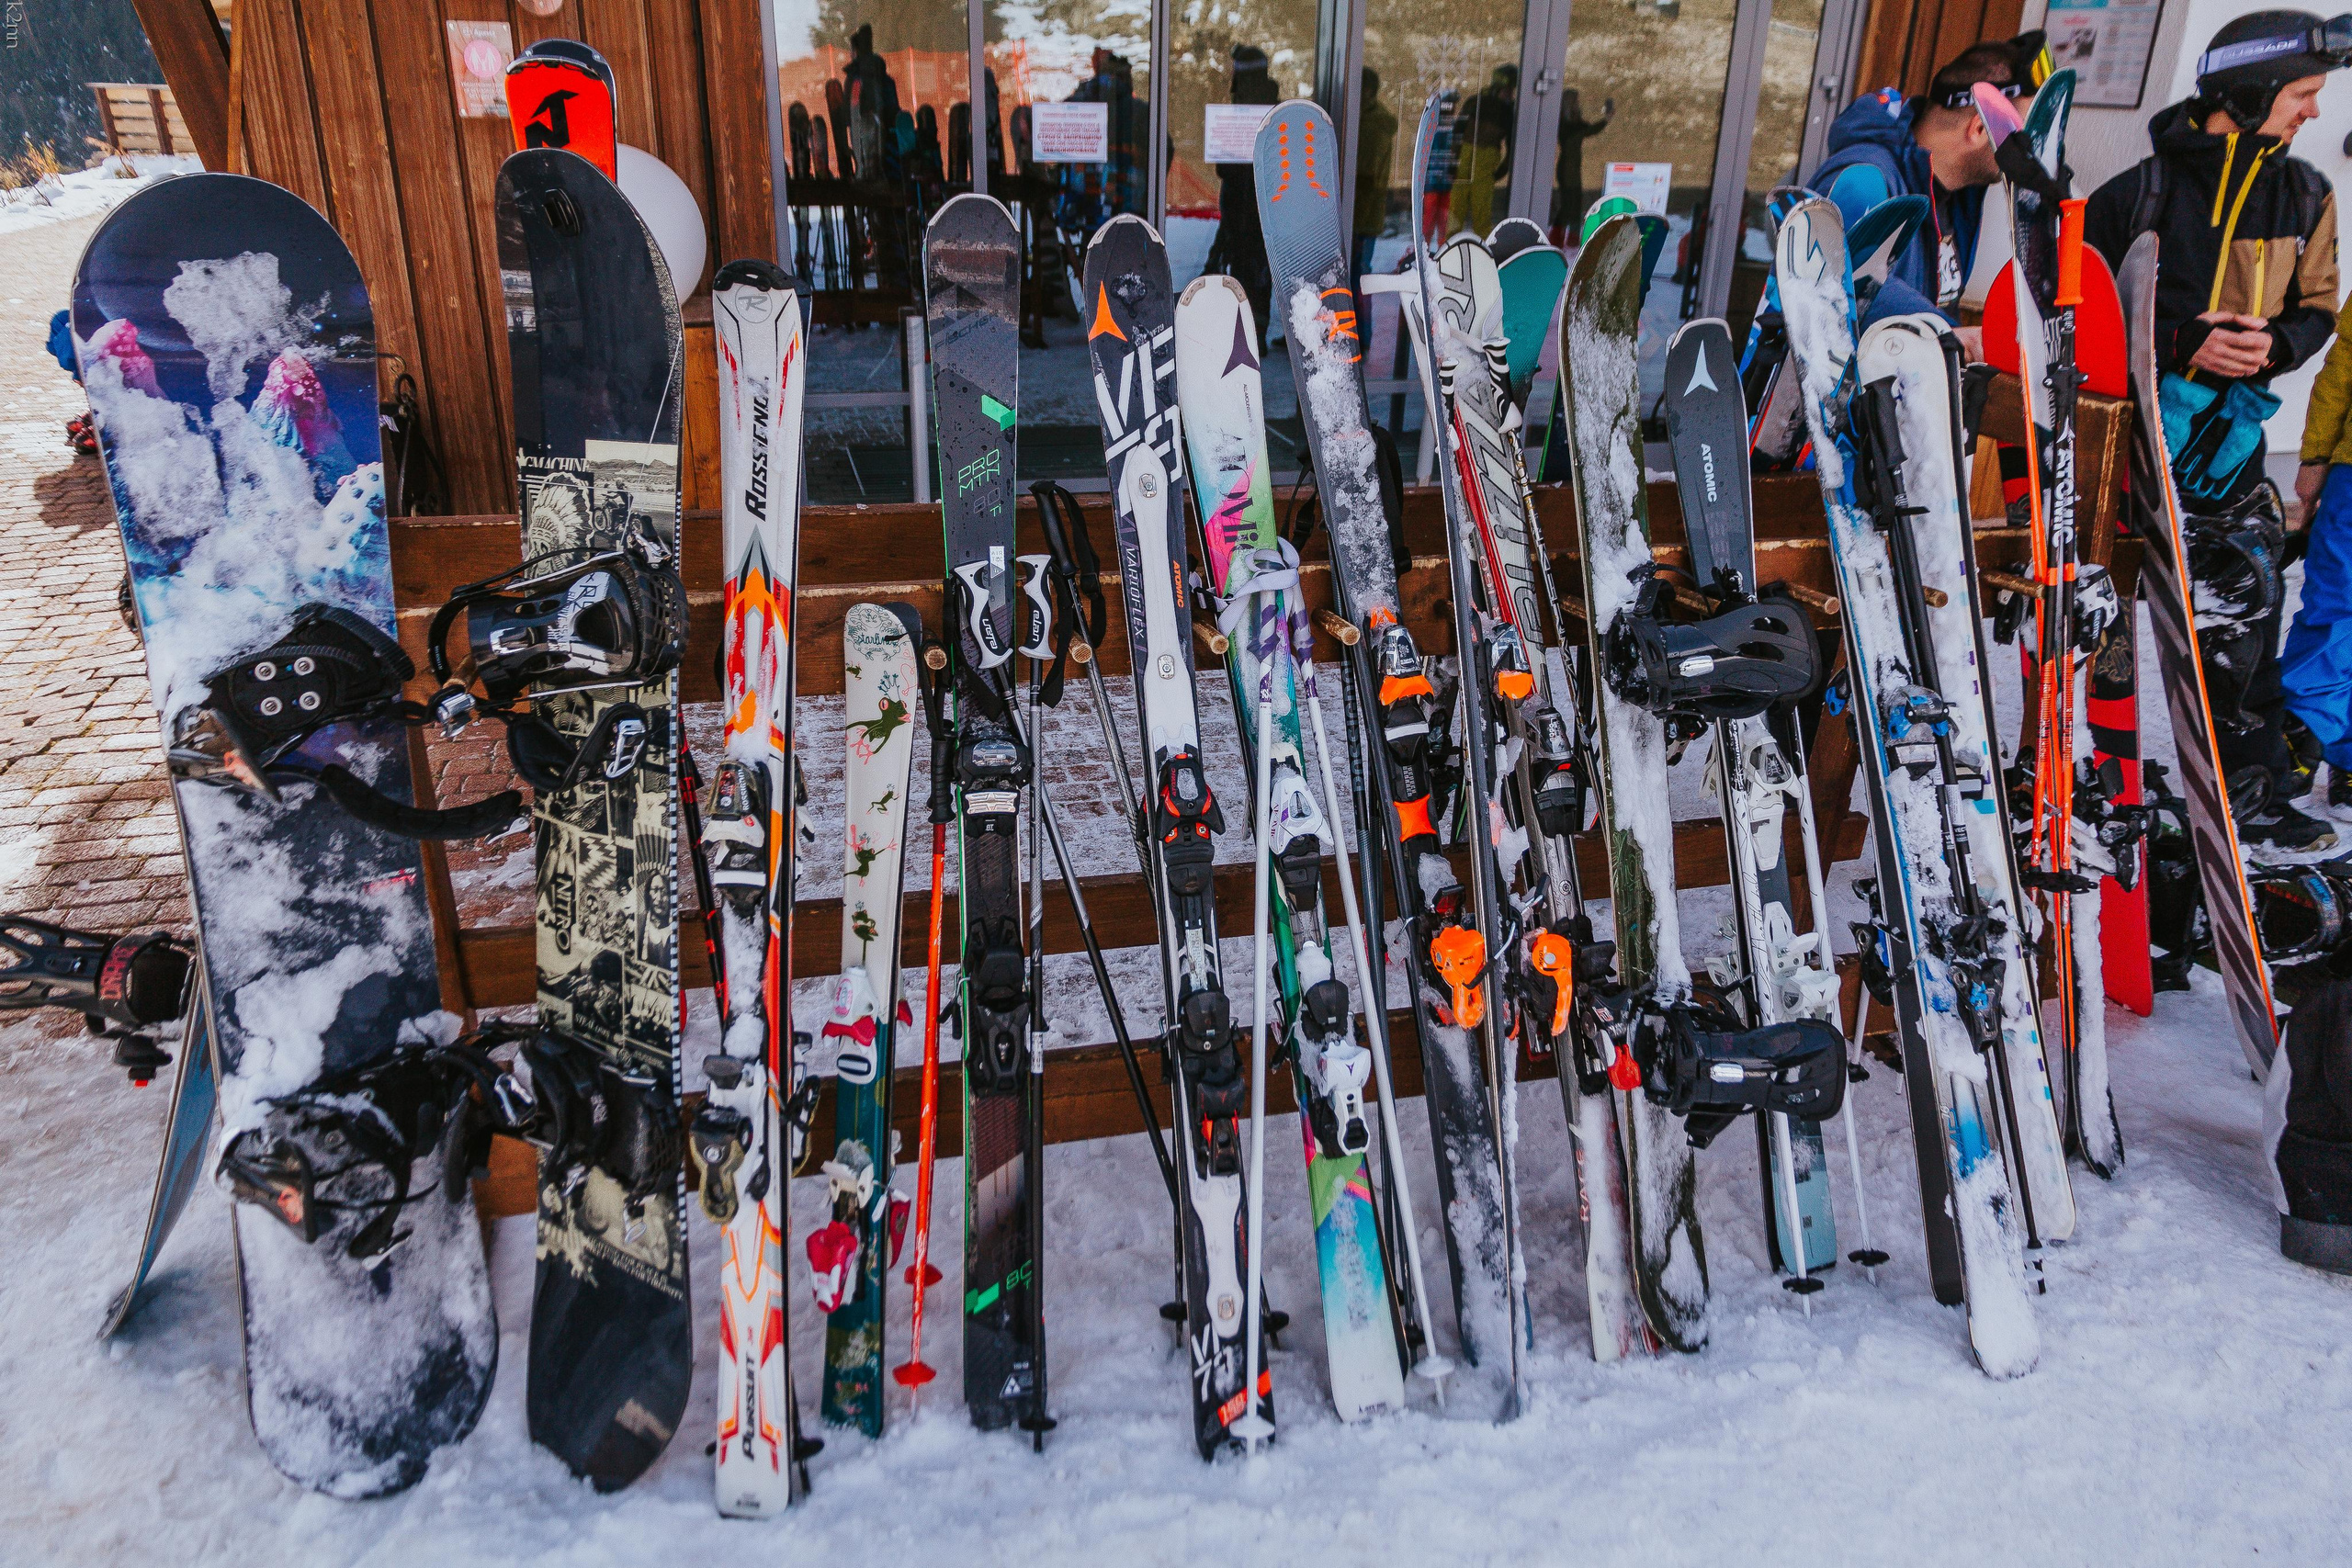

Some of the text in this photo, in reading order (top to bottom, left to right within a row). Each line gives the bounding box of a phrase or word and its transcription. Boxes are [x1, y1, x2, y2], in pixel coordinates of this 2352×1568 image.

[958, 448, 1000, 483] PRO
[959, 463, 1001, 498] MTN
[1701, 443, 1718, 502] ATOMIC
[974, 487, 1001, 513] 80
[2052, 448, 2075, 548] ATOMIC
[1125, 547, 1145, 638] VARIOFLEX
[1173, 559, 1184, 608] ATOMIC
[982, 618, 998, 649] elan
[1033, 610, 1042, 642] elan
[555, 878, 573, 951] NITRO
[1577, 1149, 1590, 1223] RACE
[741, 1353, 755, 1461] PURSUIT
